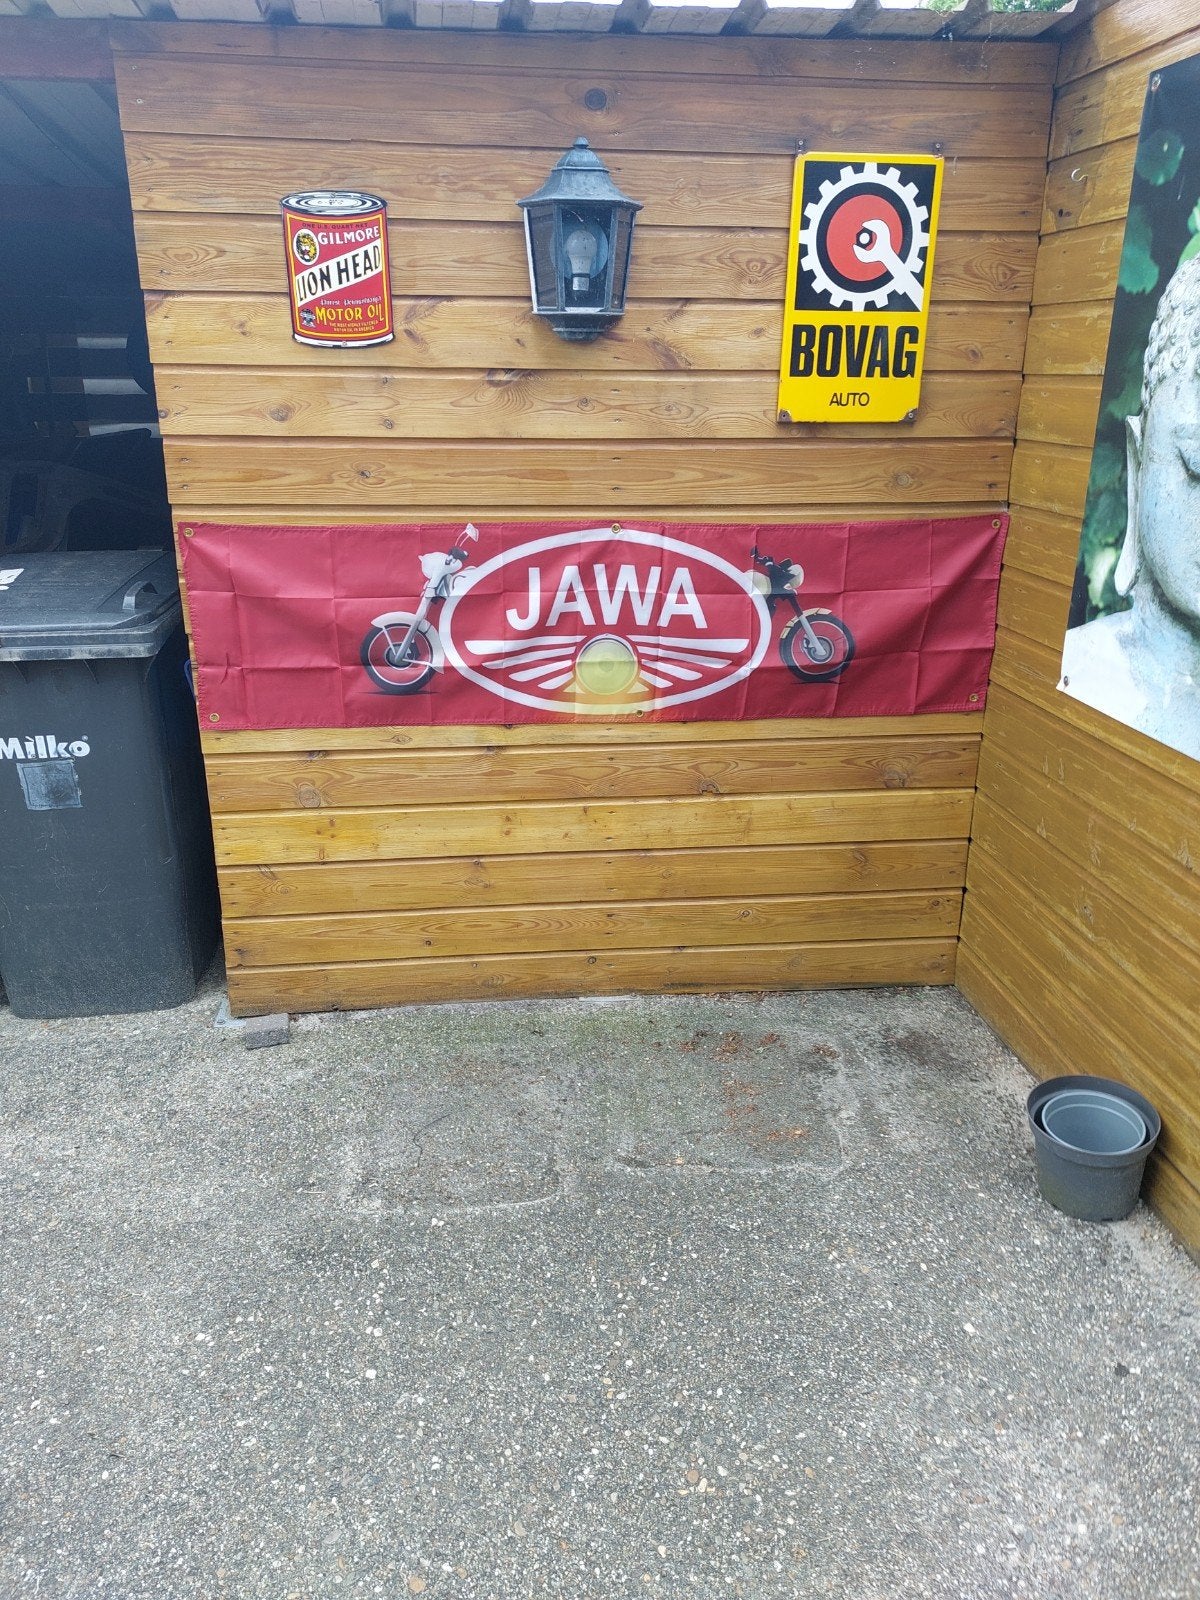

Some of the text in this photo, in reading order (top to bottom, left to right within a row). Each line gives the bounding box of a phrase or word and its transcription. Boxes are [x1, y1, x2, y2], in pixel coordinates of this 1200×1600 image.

[318, 226, 379, 245] GILMORE
[297, 245, 381, 302] LION HEAD
[315, 303, 384, 325] MOTOR OIL
[789, 324, 919, 378] BOVAG
[829, 392, 870, 406] AUTO
[505, 563, 708, 631] JAWA
